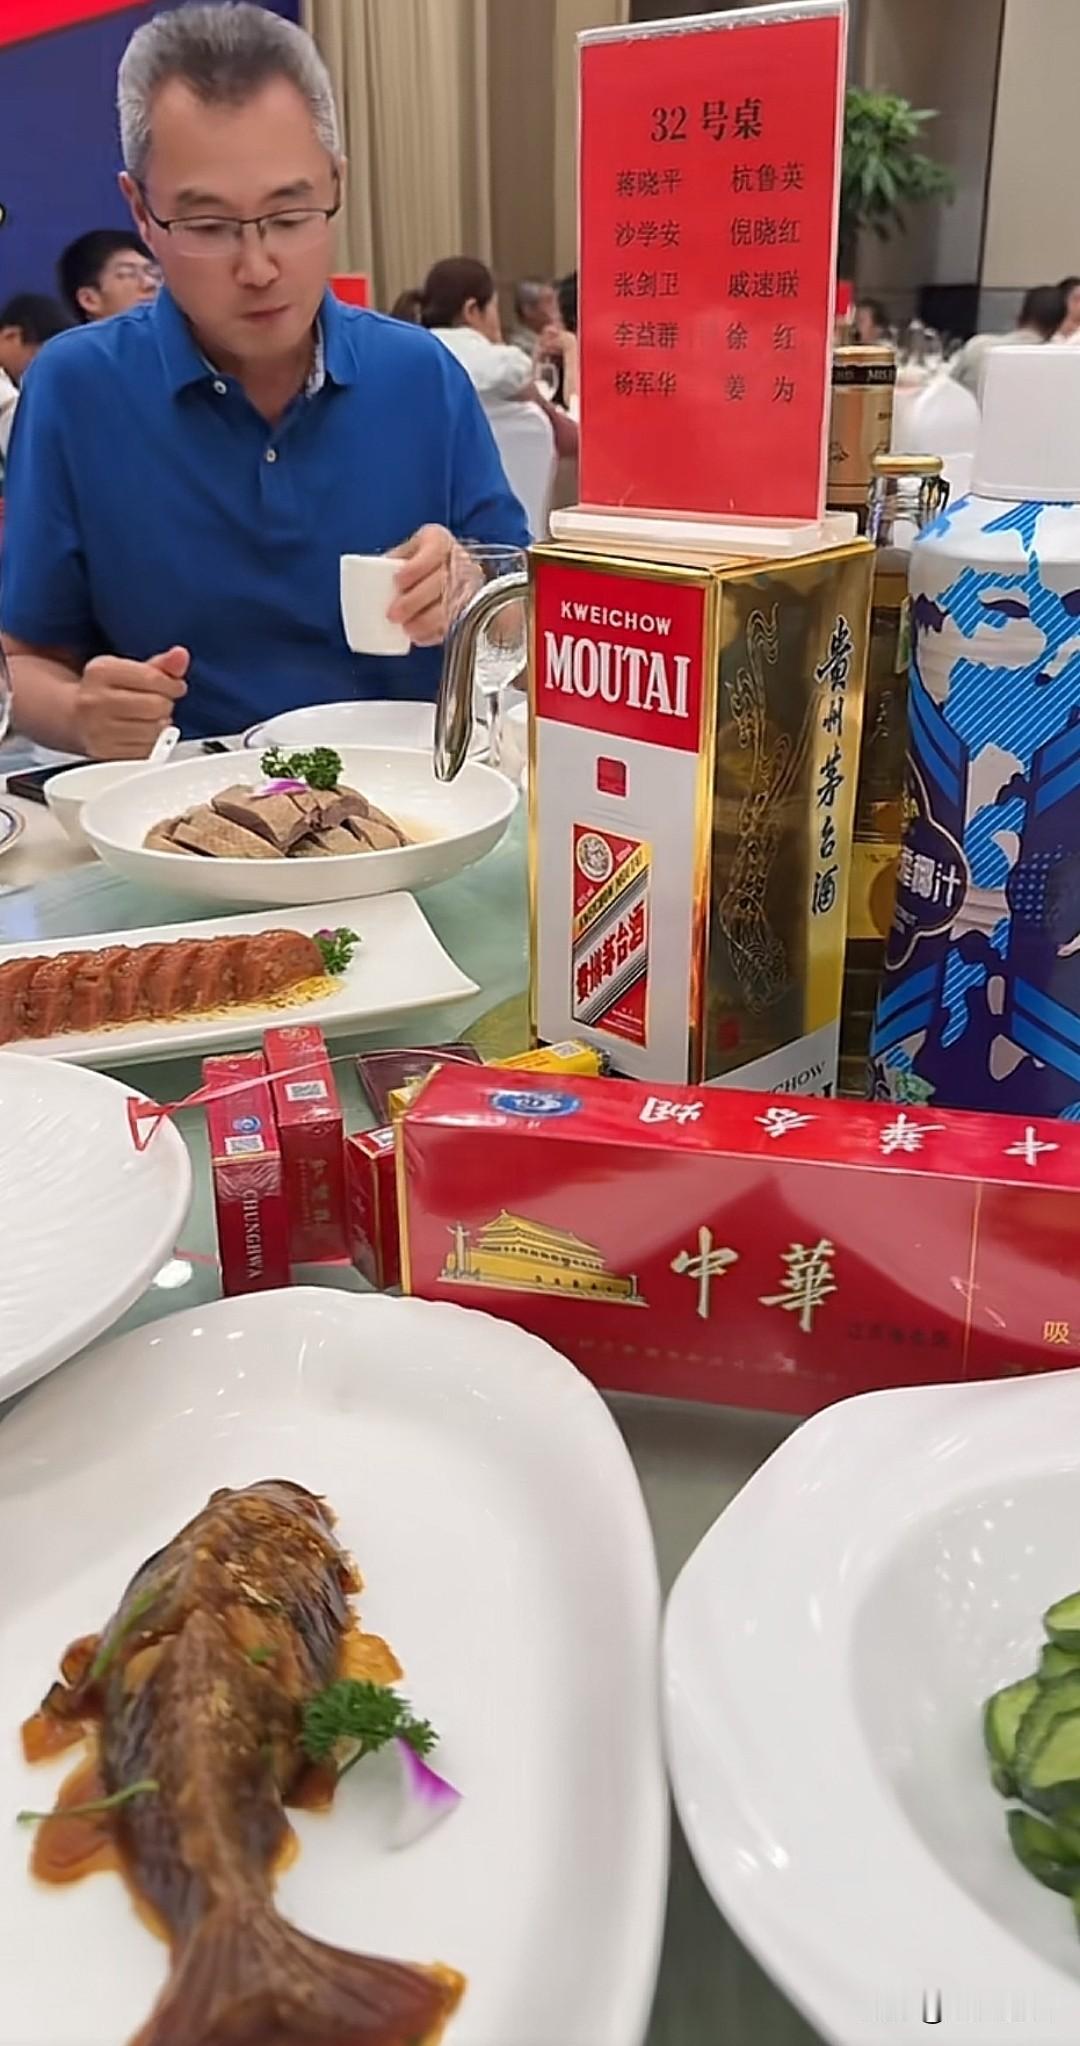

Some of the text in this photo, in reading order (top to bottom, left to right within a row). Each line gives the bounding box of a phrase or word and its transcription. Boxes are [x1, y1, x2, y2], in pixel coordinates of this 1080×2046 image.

[616, 168, 682, 197] 蒋晓平
[732, 161, 804, 193] 杭鲁英
[616, 218, 680, 247] 沙学安
[731, 217, 800, 246] 倪晓红
[614, 271, 680, 298] 张剑卫
[615, 321, 680, 349] 李益群
[615, 371, 677, 397] 杨军华
[560, 600, 672, 636] KWEICHOW
[544, 630, 691, 718] MOUTAI
[768, 1061, 826, 1094] CHOW
[243, 1189, 264, 1279] CHUNGHWA
[1043, 1320, 1071, 1345] 吸
